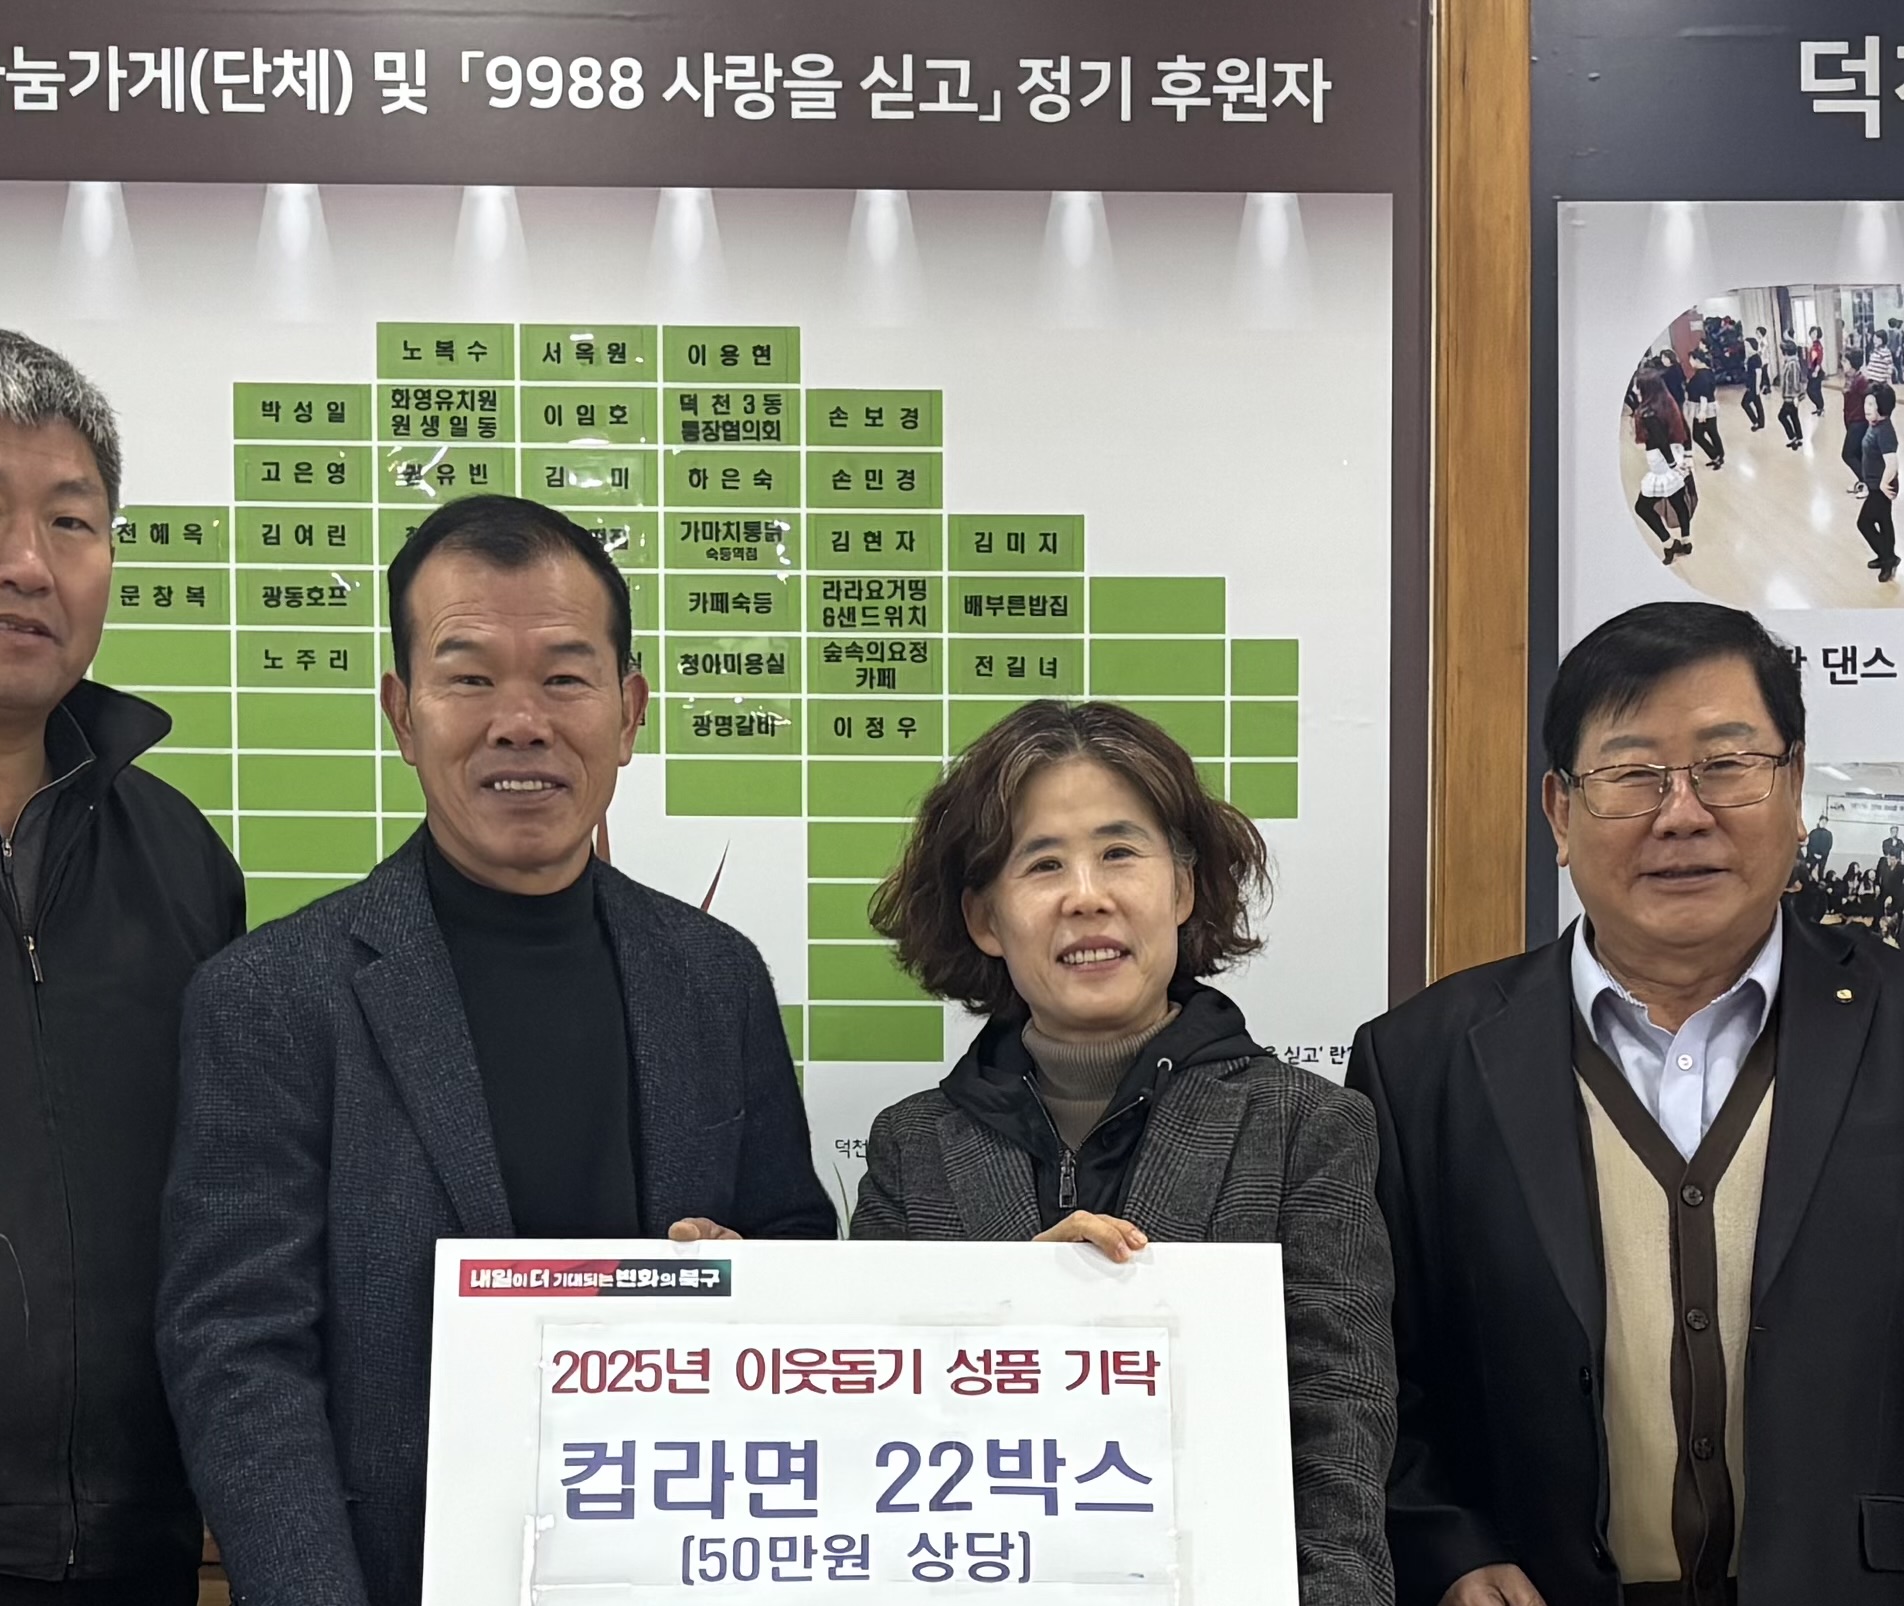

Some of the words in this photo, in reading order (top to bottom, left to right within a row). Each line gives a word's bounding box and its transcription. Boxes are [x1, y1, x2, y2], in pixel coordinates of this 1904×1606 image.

[375, 49, 427, 114] 및
[663, 53, 842, 119] 사랑을
[860, 54, 1000, 121] 싣고」
[1018, 56, 1130, 122] 정기
[1152, 55, 1331, 123] 후원자
[392, 389, 496, 412] 화영유치원
[546, 466, 628, 489] 김미
[689, 592, 772, 614] 카페숙등
[965, 595, 1067, 616] 배부른밥집
[824, 641, 927, 663] 숲속의요정
[1822, 646, 1897, 684] 댄스
[856, 668, 895, 689] 카페
[552, 1348, 709, 1394] 2025년
[736, 1348, 921, 1394] 이웃돕기
[947, 1349, 1041, 1395] 성품
[1065, 1350, 1160, 1396] 기탁
[561, 1440, 818, 1519] 컵라면
[876, 1439, 1153, 1516] 22박스
